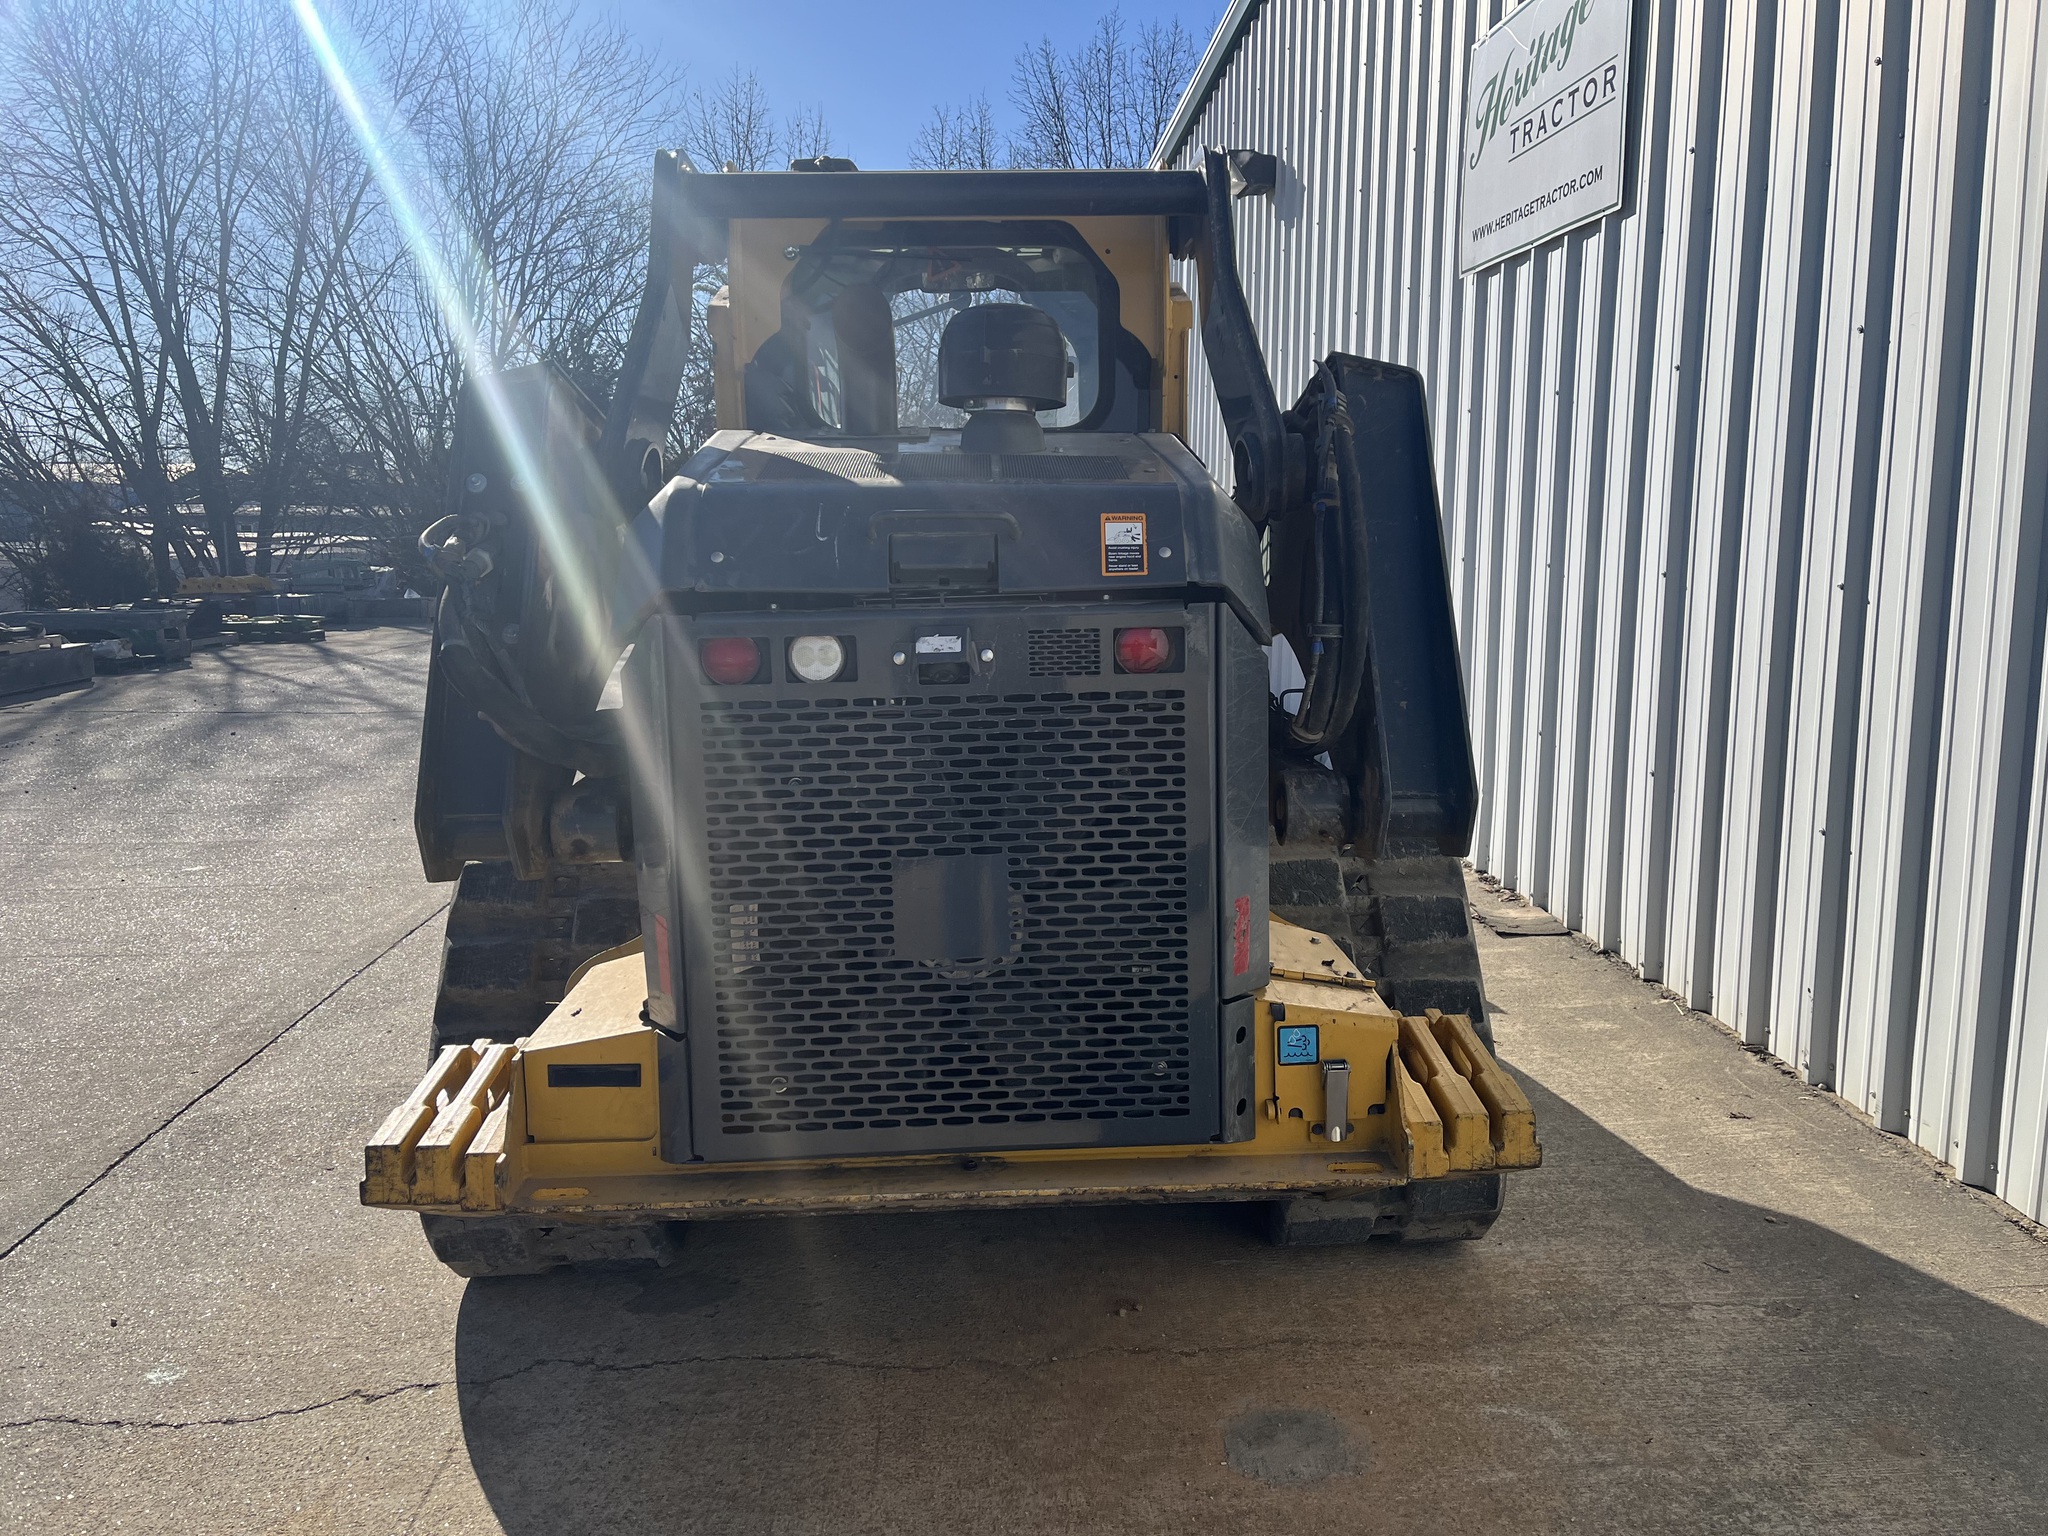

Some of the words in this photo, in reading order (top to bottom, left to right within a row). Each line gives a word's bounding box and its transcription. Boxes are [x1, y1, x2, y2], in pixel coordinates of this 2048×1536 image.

[1470, 0, 1595, 170] Heritage
[1509, 64, 1617, 154] TRACTOR
[1472, 165, 1603, 243] WWW.HERITAGETRACTOR.COM
